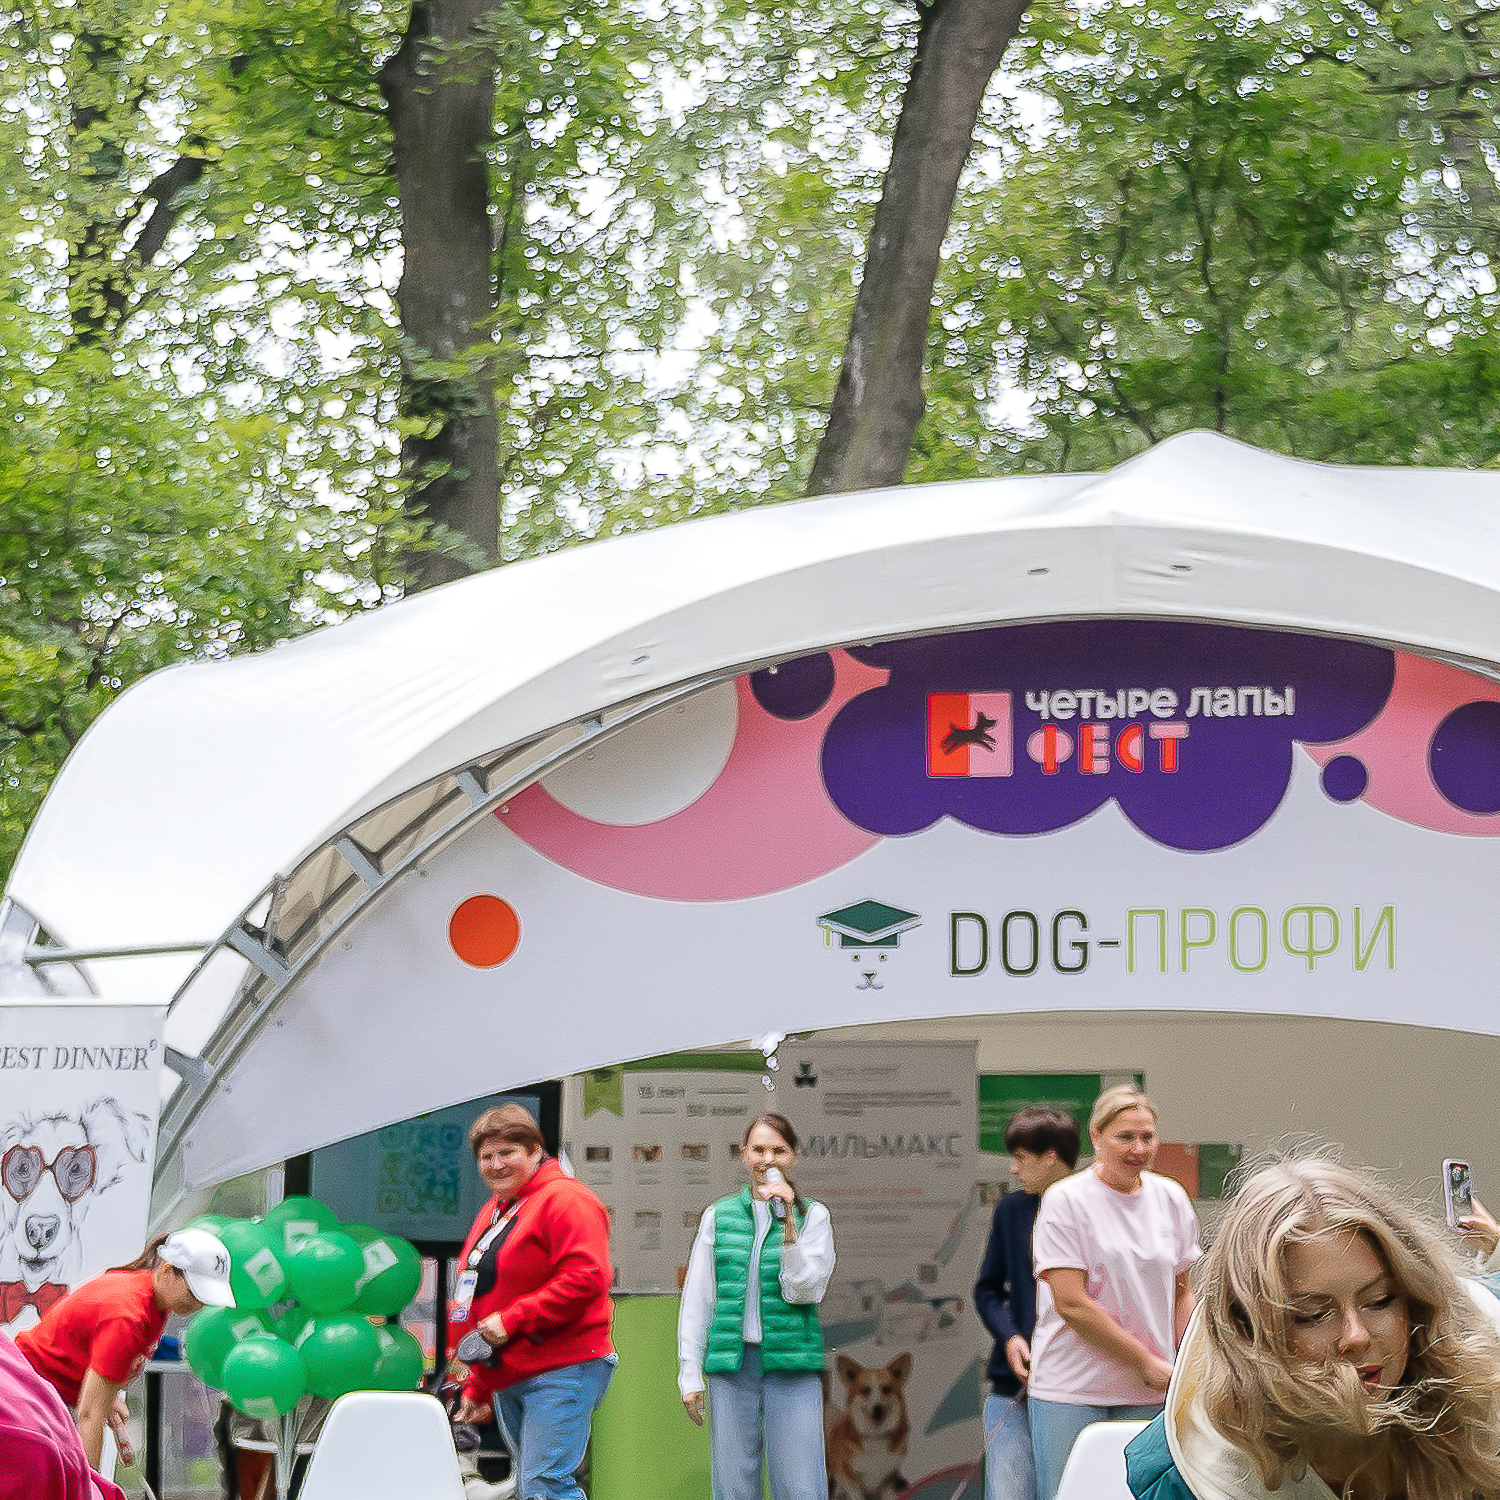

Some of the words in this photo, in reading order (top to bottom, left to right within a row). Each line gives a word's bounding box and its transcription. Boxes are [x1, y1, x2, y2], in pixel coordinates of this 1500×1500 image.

[1025, 687, 1180, 720] четыре
[1185, 685, 1297, 718] лапы
[1026, 722, 1190, 775] ФЕСТ
[949, 904, 1397, 978] DOG-ПРОФИ
